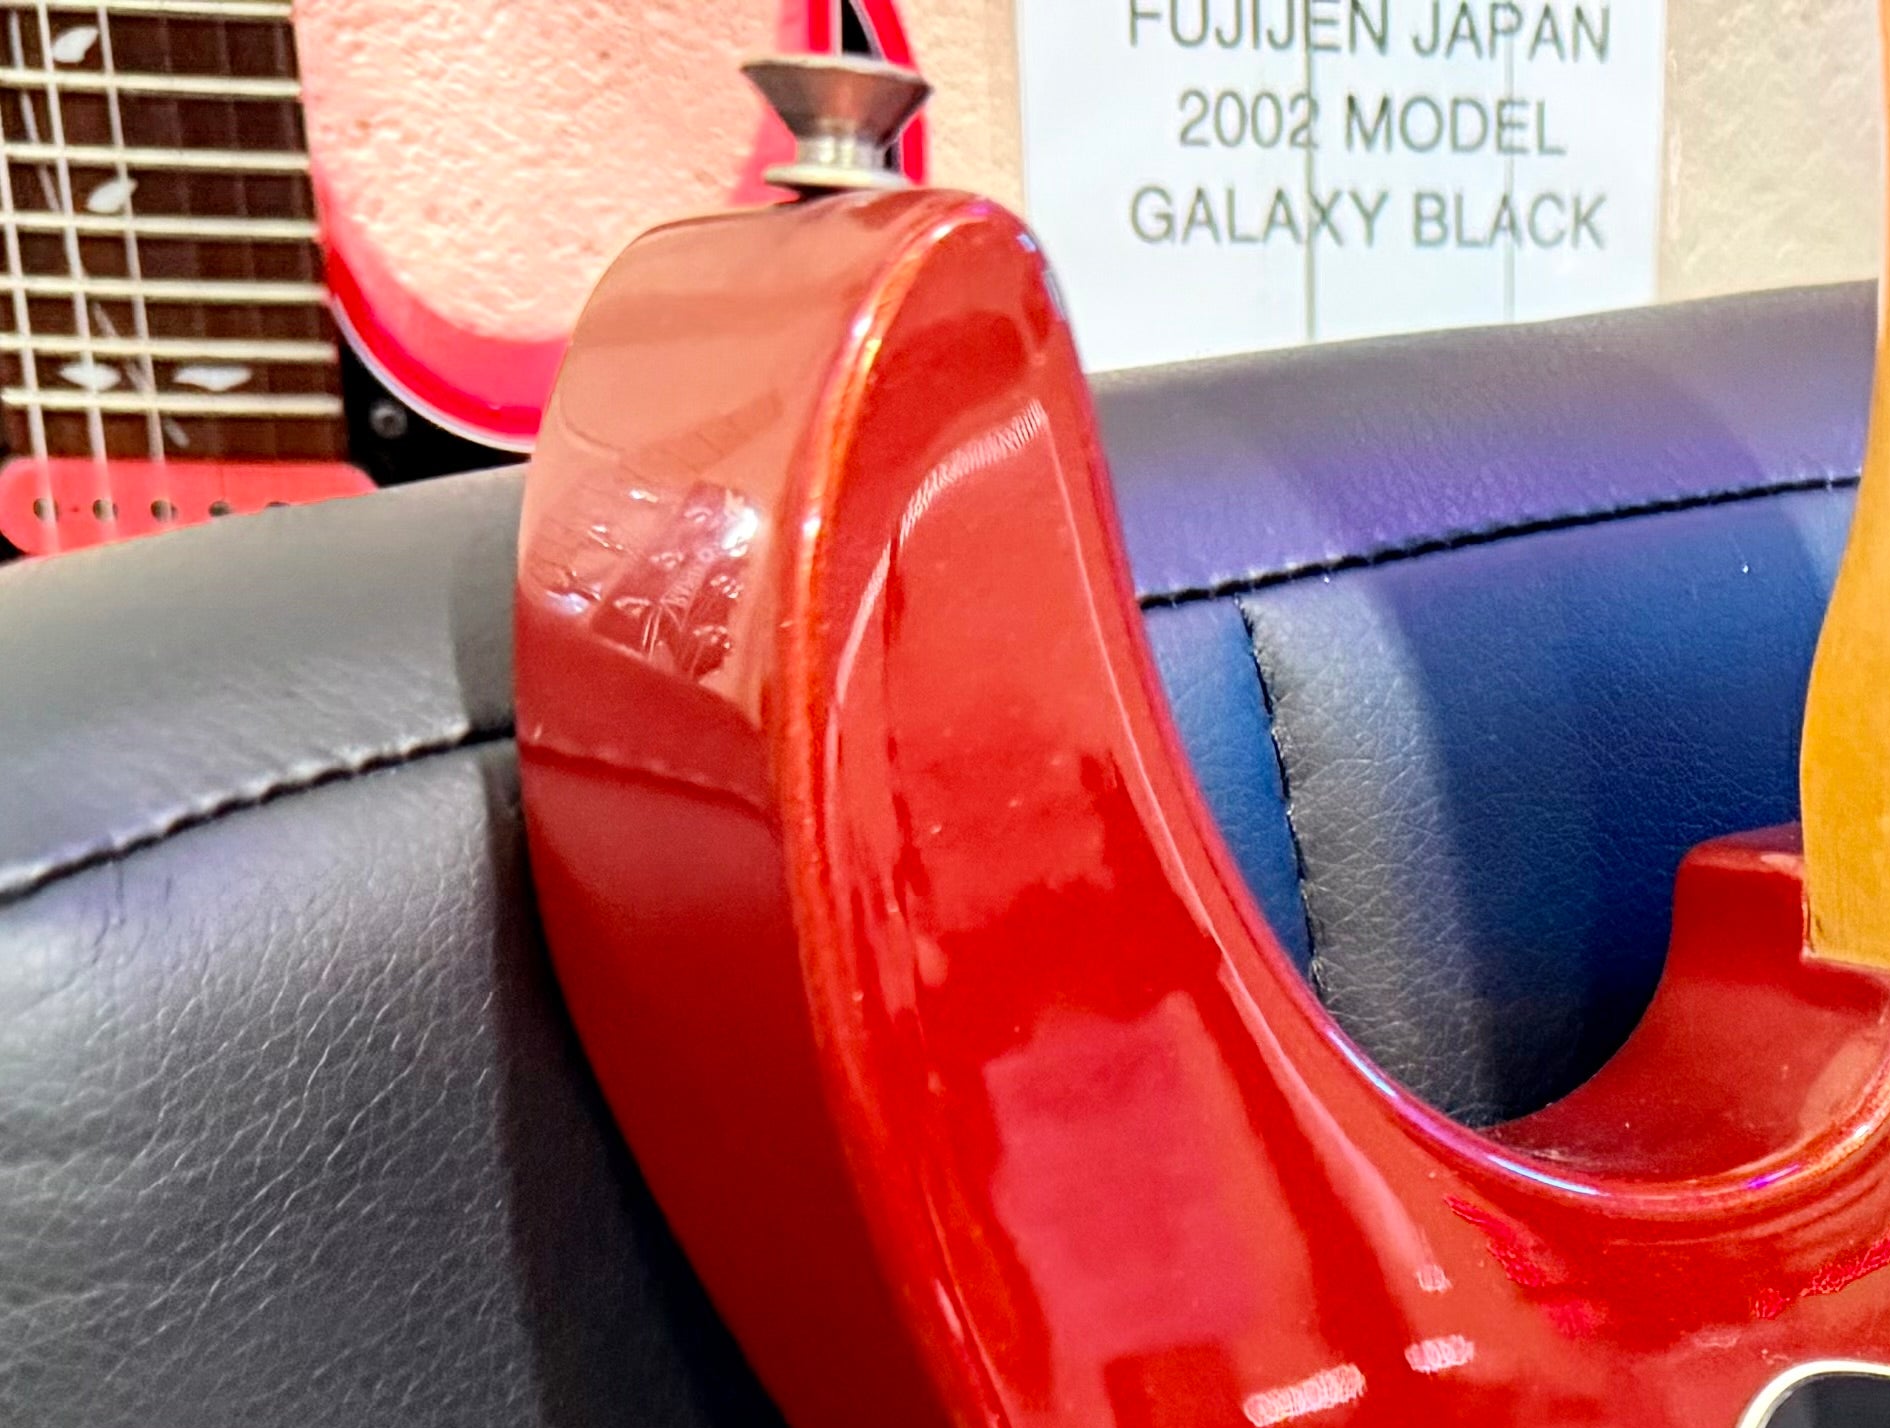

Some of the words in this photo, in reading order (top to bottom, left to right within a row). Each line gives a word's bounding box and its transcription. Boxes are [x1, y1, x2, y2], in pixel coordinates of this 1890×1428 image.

[1413, 0, 1610, 63] JAPAN
[1178, 90, 1319, 150] 2002
[1346, 95, 1567, 157] MODEL
[1129, 185, 1389, 246] GALAXY
[1413, 192, 1607, 250] BLACK
